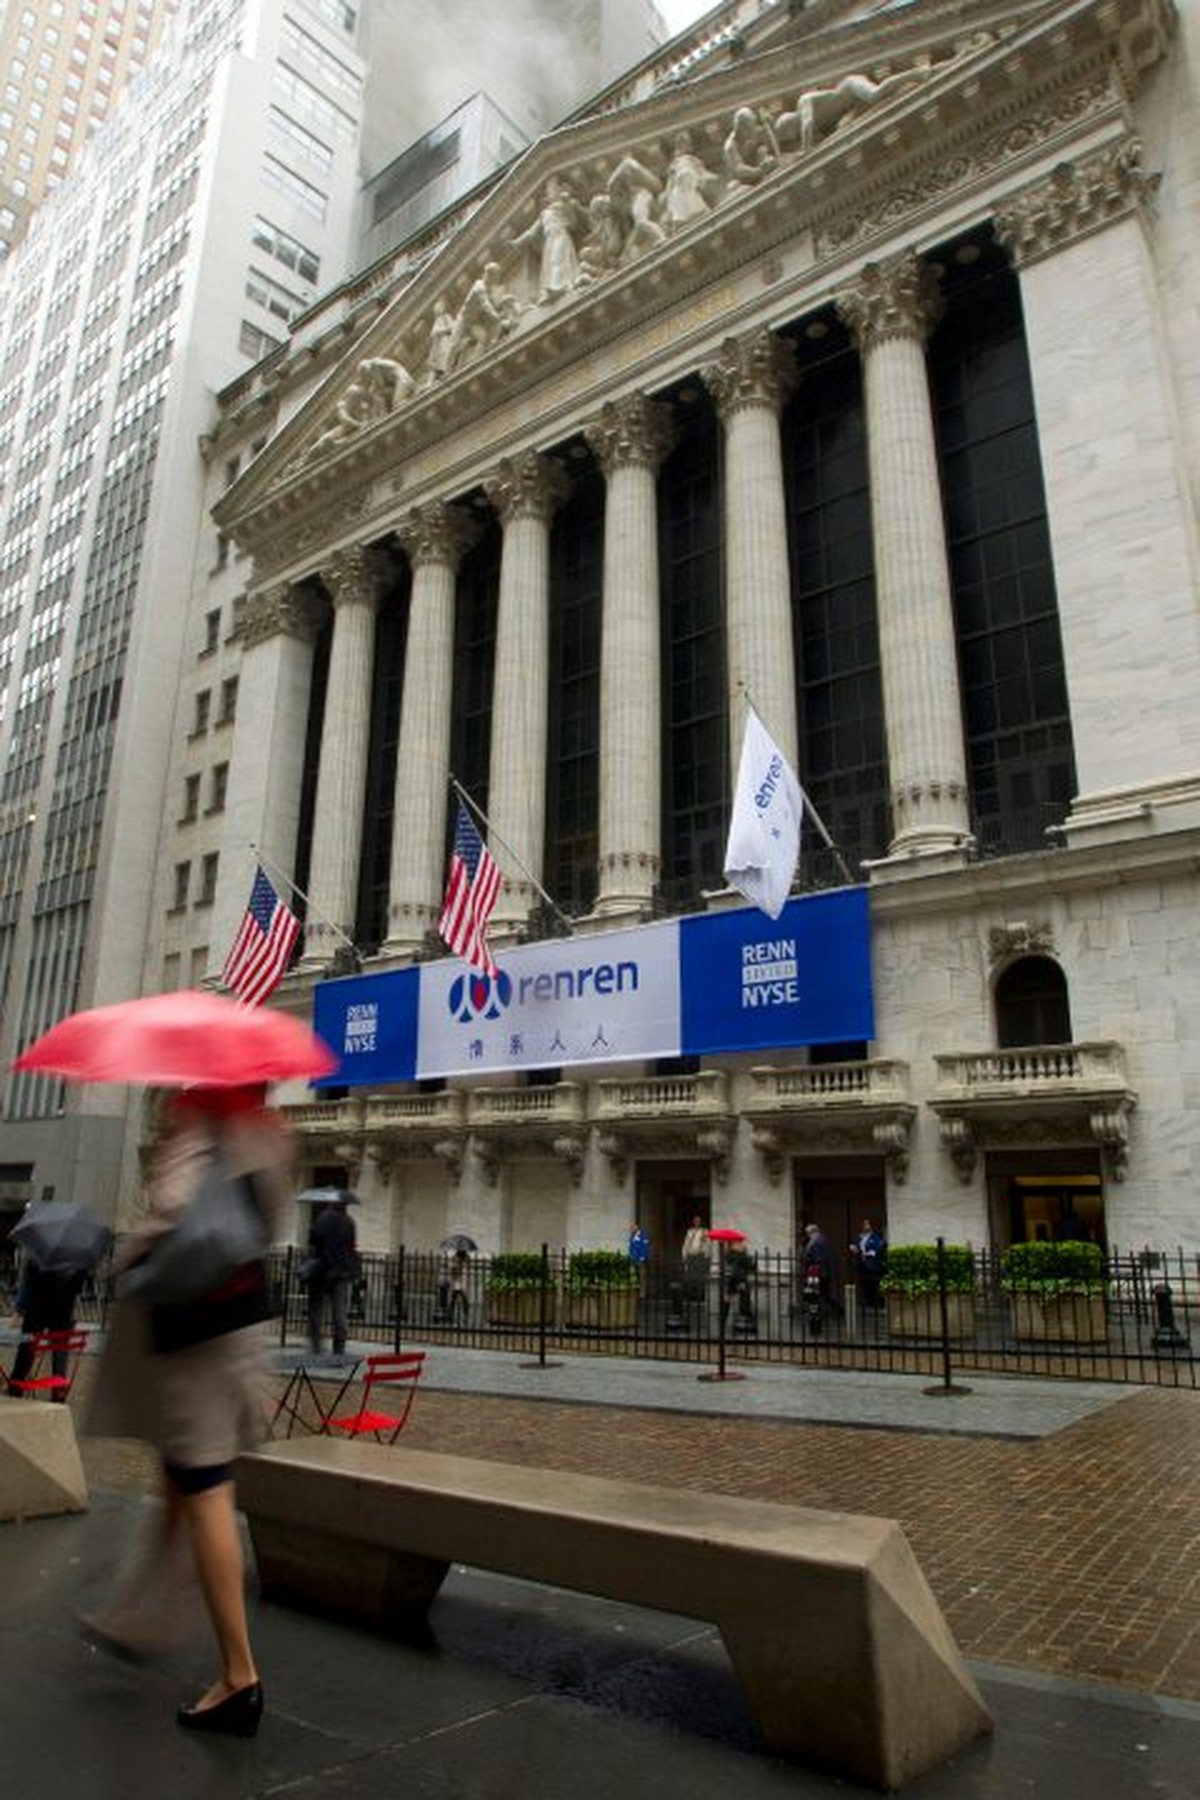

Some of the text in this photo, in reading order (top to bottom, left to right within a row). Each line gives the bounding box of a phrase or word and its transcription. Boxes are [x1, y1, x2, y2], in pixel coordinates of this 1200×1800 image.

[741, 938, 797, 966] RENN
[518, 960, 639, 1006] renren
[741, 980, 800, 1009] NYSE
